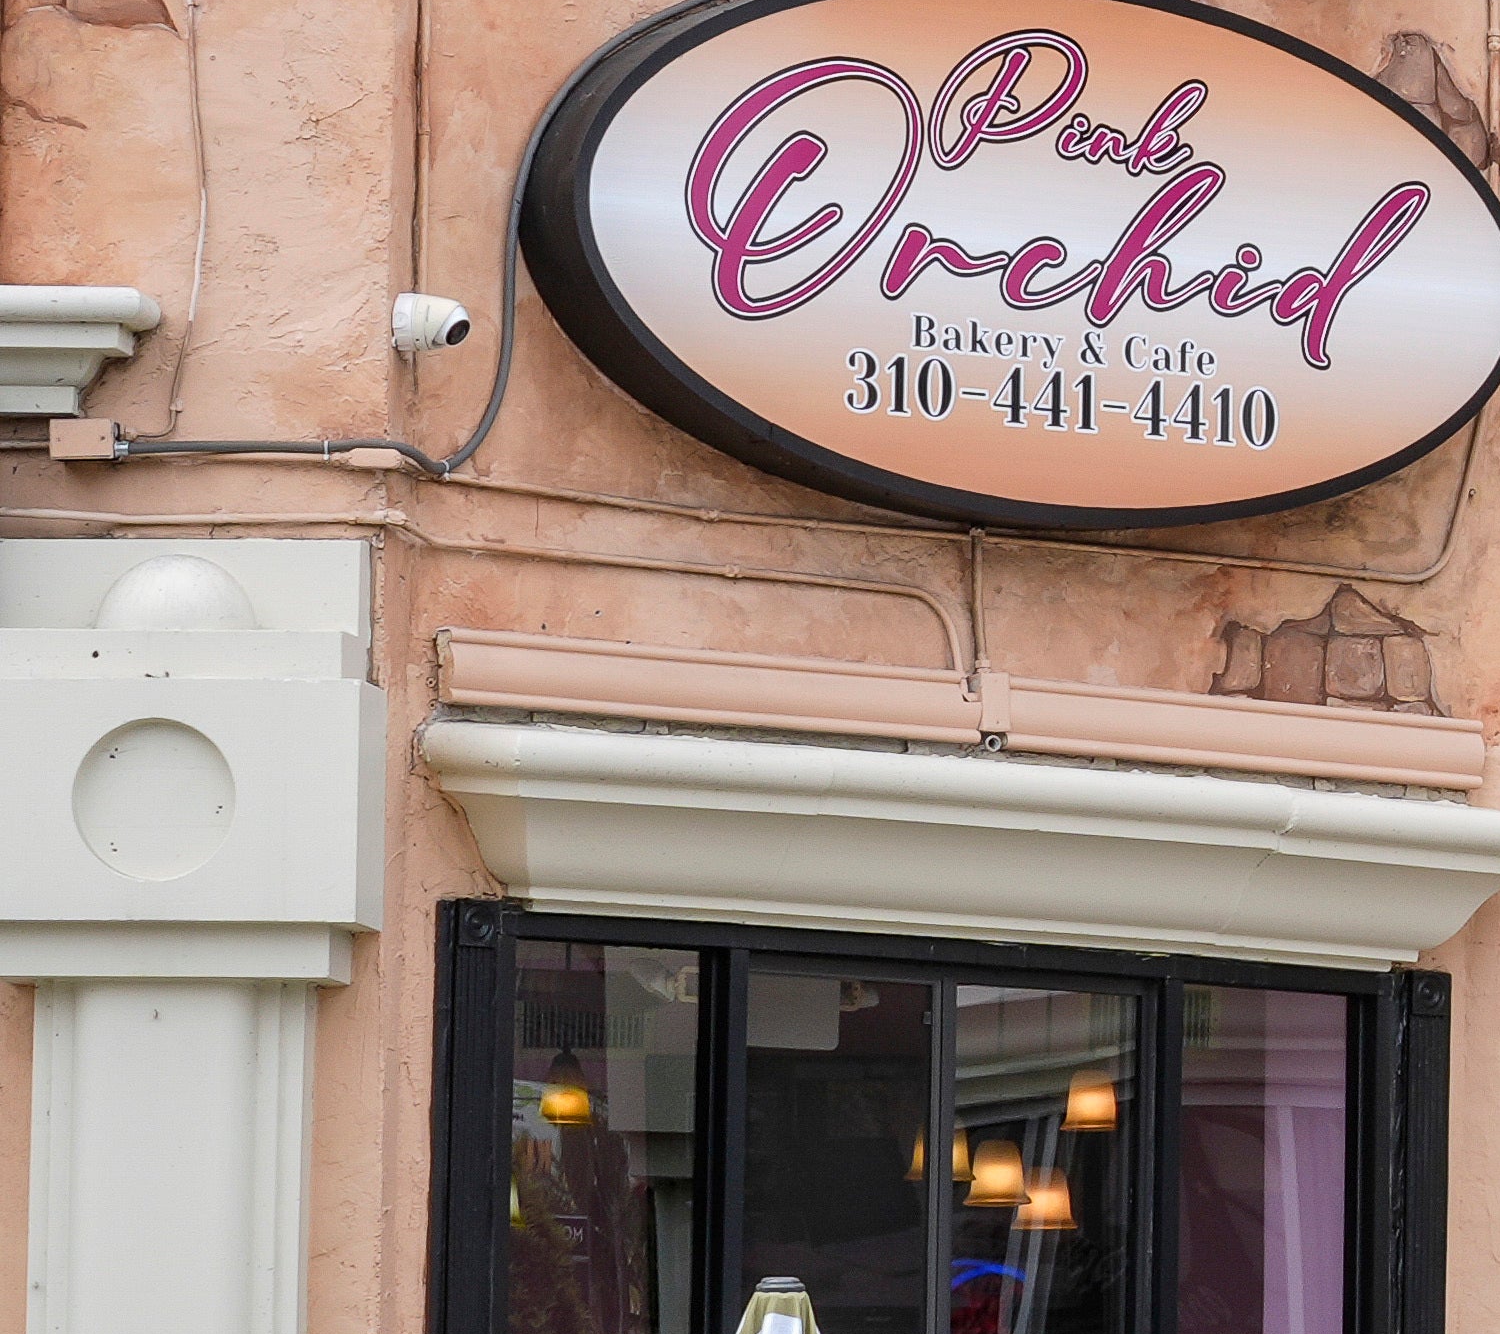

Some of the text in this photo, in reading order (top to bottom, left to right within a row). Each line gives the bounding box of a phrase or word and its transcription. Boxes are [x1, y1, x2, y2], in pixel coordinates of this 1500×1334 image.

[930, 29, 1209, 175] Pink
[685, 56, 1431, 371] Orchid
[843, 348, 1278, 452] 310-441-4410
[912, 312, 1216, 377] Bakery & Cafe
